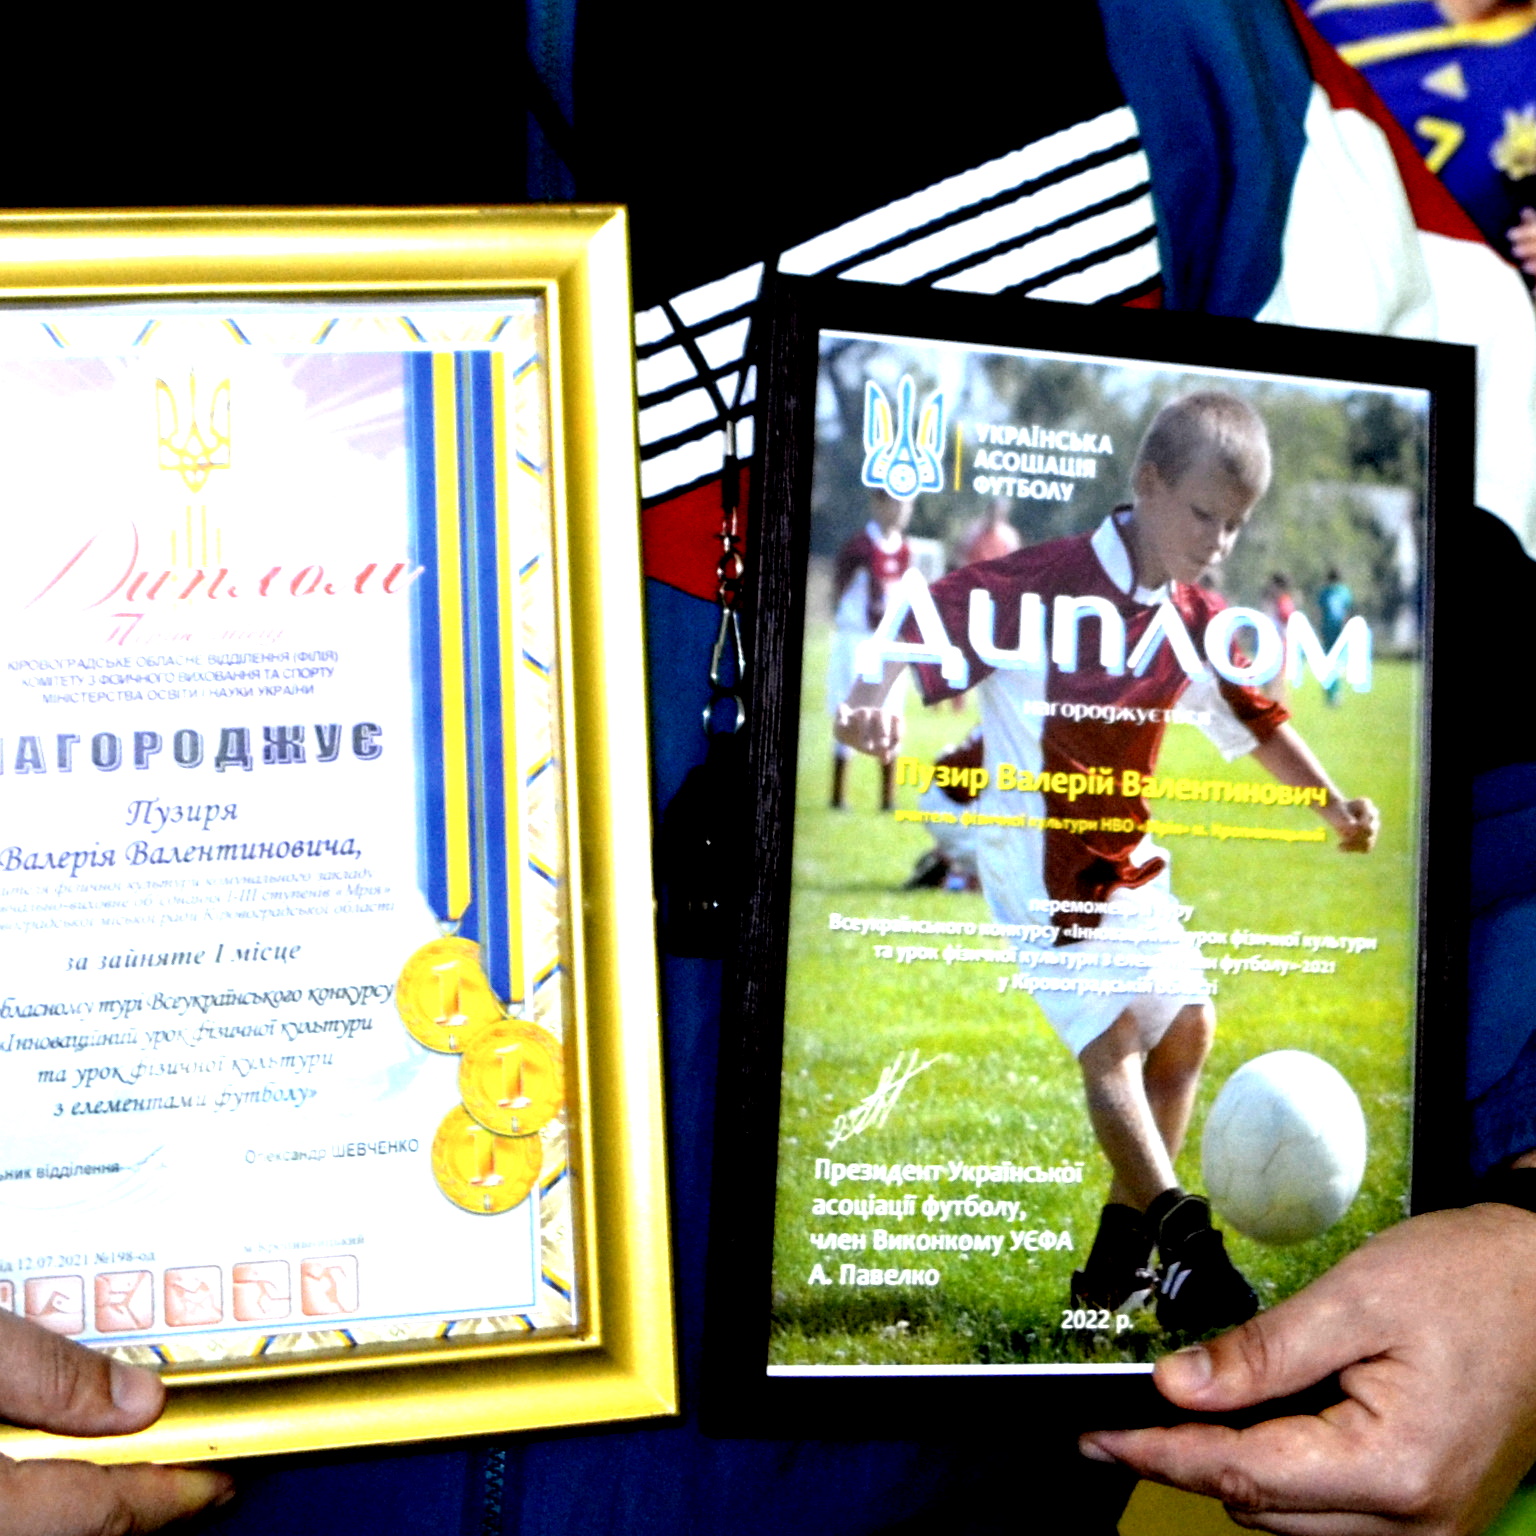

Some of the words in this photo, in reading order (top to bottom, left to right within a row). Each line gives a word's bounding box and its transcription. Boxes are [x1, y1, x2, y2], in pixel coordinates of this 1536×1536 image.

[1414, 114, 1463, 174] 7
[973, 419, 1114, 455] УКРАЇНСЬКА
[973, 450, 1098, 479] АСОЦІАЦІЯ
[972, 474, 1076, 502] ФУТБОЛУ
[7, 657, 132, 671] КІРОВОГРАДСЬКЕ
[136, 655, 203, 668] ОБЛАСНЕ
[207, 652, 290, 666] ВІДДІЛЕННЯ
[293, 650, 339, 663] (ФІЛІЯ)
[22, 674, 84, 688] КОМІТЕТУ
[178, 669, 261, 683] ВИХОВАННЯ
[264, 668, 280, 681] ТА
[283, 666, 335, 680] СПОРТУ
[42, 690, 144, 704] МІНІСТЕРСТВА
[147, 688, 198, 702] ОСВІТИ
[209, 687, 254, 699] НАУКИ
[258, 683, 314, 697] УКРАЇНИ
[895, 756, 990, 796] Пузир
[996, 763, 1114, 801] Валерій
[1122, 770, 1327, 807] Валентинович
[125, 797, 239, 834] Пузиря
[1101, 818, 1134, 832] НВО
[125, 833, 364, 868] Валентиновича,
[829, 913, 977, 936] Всеукраїнського
[980, 923, 1059, 944] конкурсу
[1230, 929, 1301, 950] фізичної
[1302, 935, 1378, 954] культури
[66, 953, 89, 973] за
[96, 946, 207, 972] зайняте
[231, 939, 303, 966] місце
[874, 945, 893, 960] та
[896, 946, 939, 963] урок
[942, 944, 1018, 964] фізичної
[1020, 951, 1098, 970] культури
[997, 976, 1010, 992] у
[99, 992, 145, 1023] турі
[147, 982, 304, 1016] Всеукраїнського
[308, 981, 396, 1010] конкурсу
[281, 1015, 374, 1042] культури
[37, 1065, 68, 1085] та
[73, 1061, 134, 1089] урок
[53, 1098, 65, 1118] з
[70, 1089, 208, 1117] елементами
[245, 1146, 327, 1166] Оександр
[331, 1138, 421, 1159] ШЕВЧЕНКО
[36, 1158, 122, 1181] відділення
[814, 1158, 943, 1186] Президент
[946, 1159, 1084, 1187] Української
[811, 1194, 917, 1220] асоціації
[920, 1193, 1028, 1223] футболу,
[809, 1231, 864, 1251] член
[872, 1230, 1005, 1257] Виконкому
[1009, 1230, 1074, 1252] УЄФА
[808, 1264, 833, 1285] А.
[839, 1265, 940, 1288] Павелко
[1061, 1309, 1110, 1331] 2022
[1115, 1312, 1135, 1334] р.
